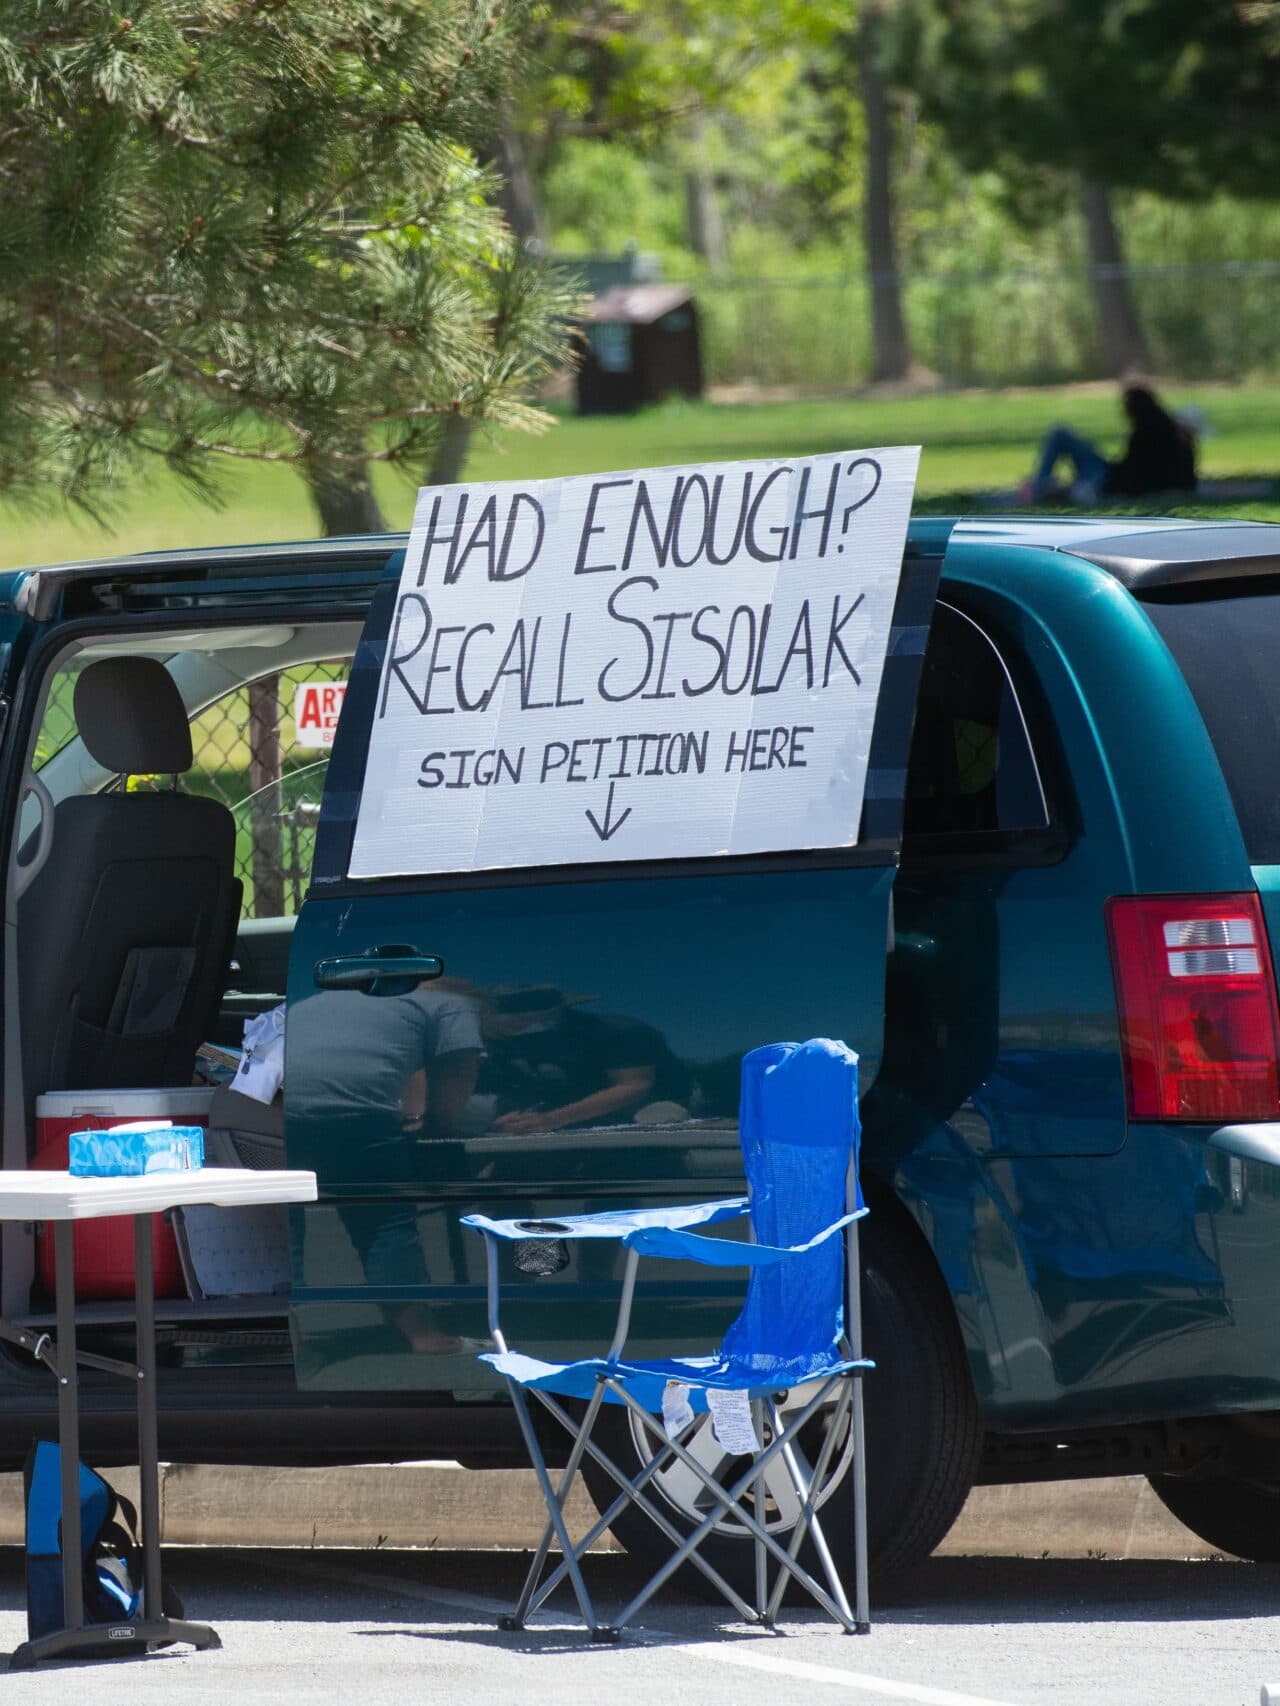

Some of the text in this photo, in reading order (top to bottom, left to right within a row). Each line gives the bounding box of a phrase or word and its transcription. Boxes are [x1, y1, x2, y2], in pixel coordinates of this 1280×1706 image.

[417, 457, 882, 587] HAD ENOUGH?
[380, 576, 865, 718] RECALL SISOLAK
[418, 726, 814, 788] SIGN PETITION HERE
